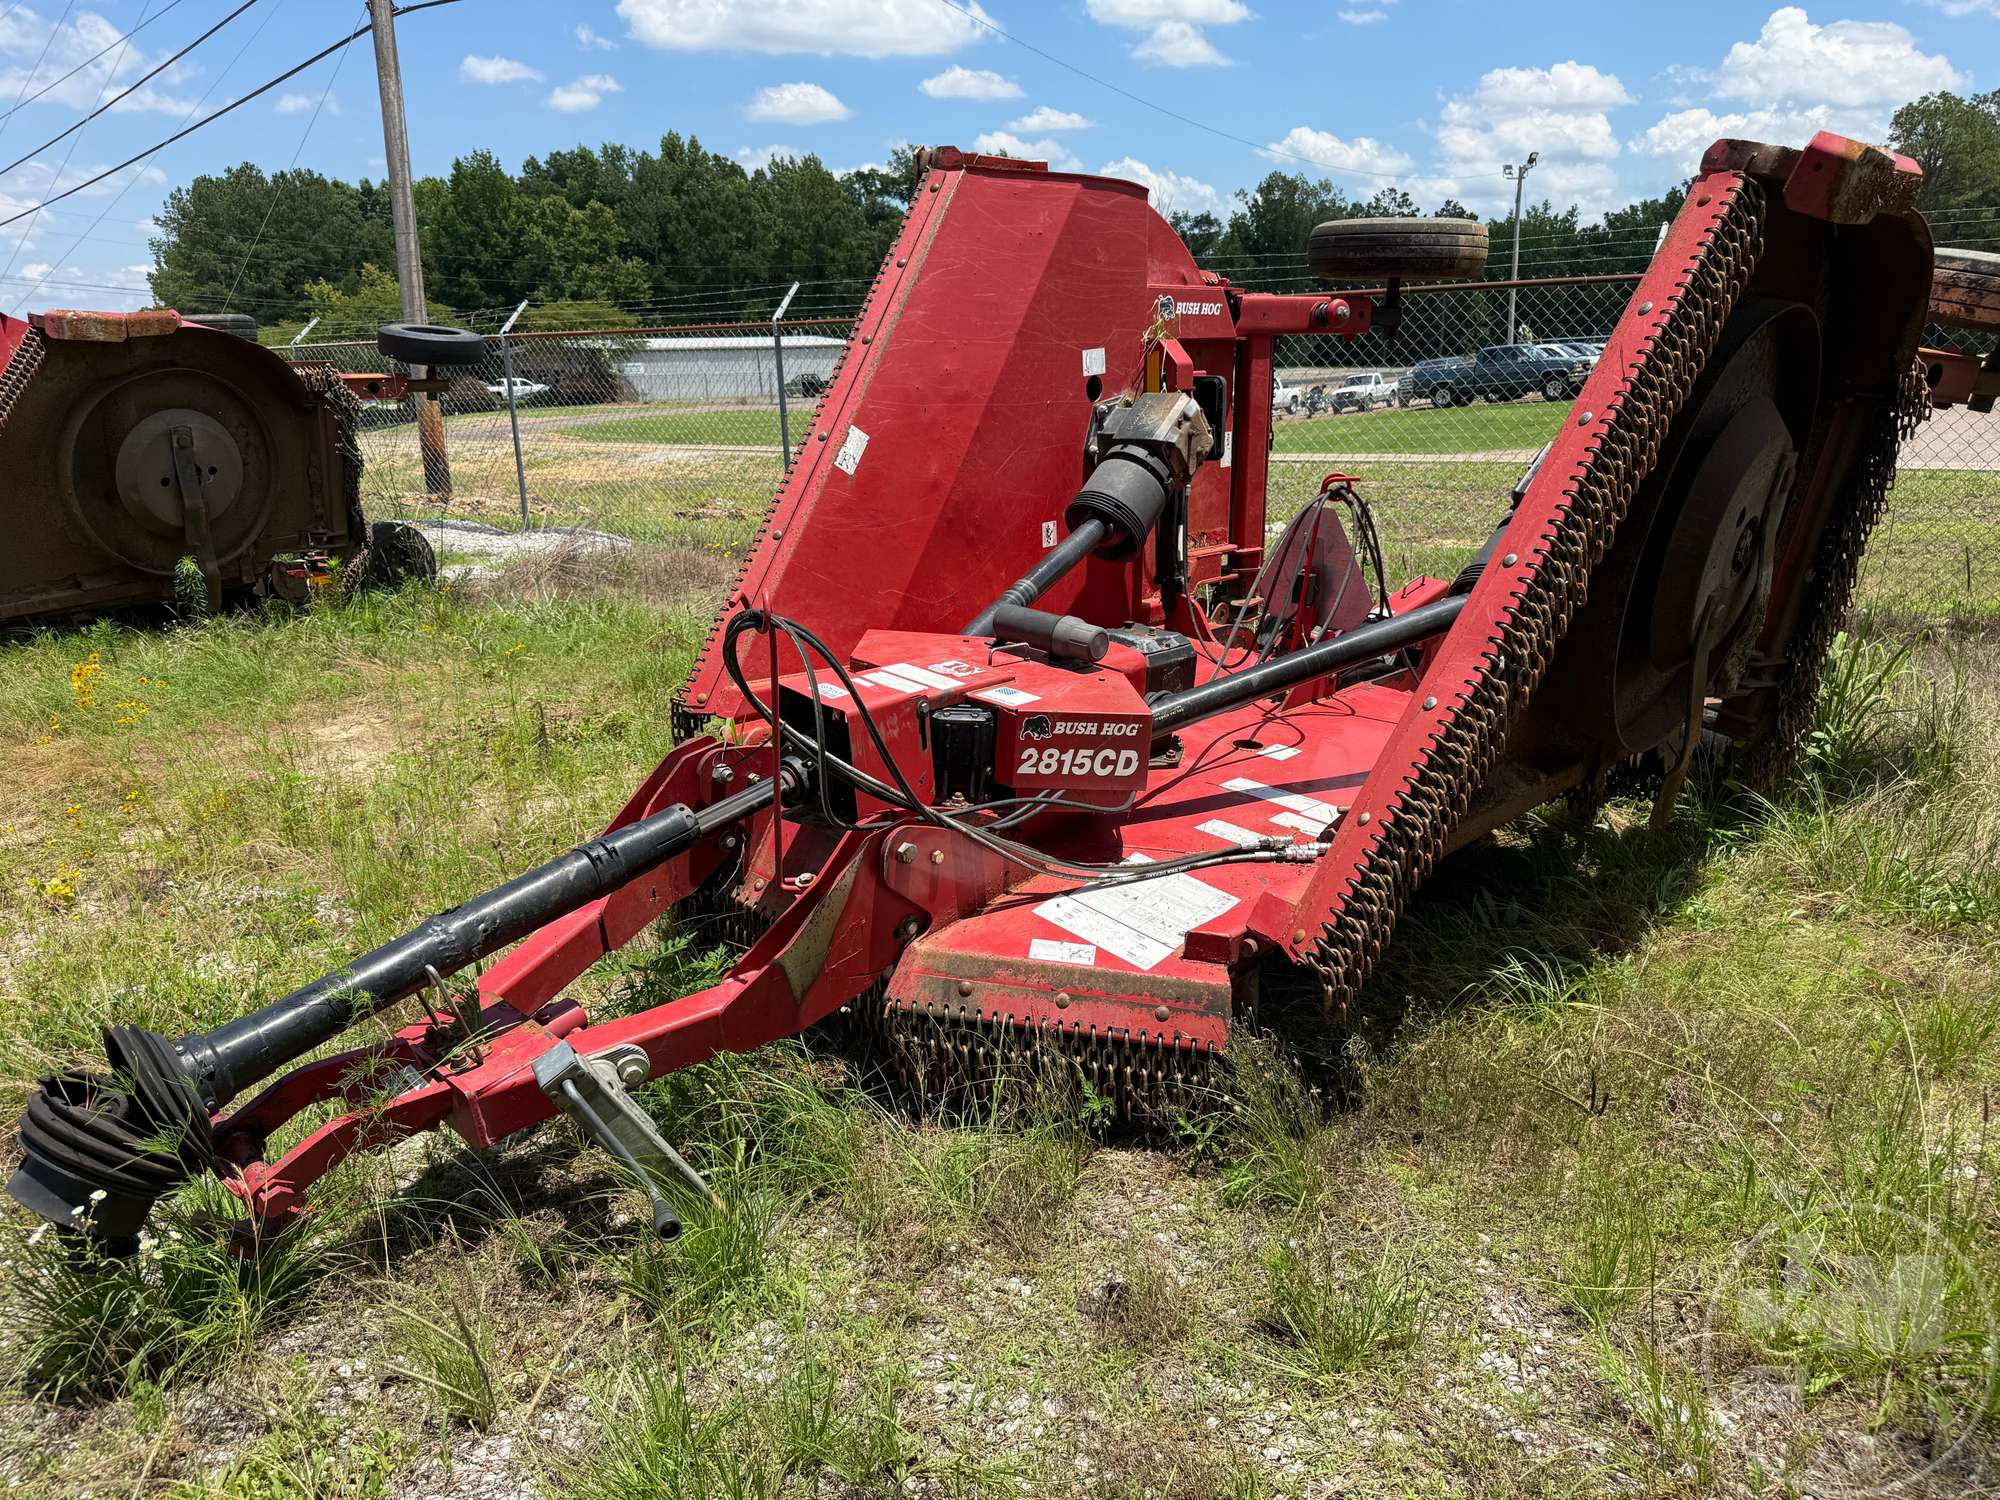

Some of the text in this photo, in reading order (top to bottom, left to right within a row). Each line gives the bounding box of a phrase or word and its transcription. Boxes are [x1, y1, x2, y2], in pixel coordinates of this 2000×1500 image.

[1176, 302, 1221, 315] BUSH HOG
[1053, 722, 1138, 736] BUSH HOG
[1017, 747, 1139, 776] 2815CD
